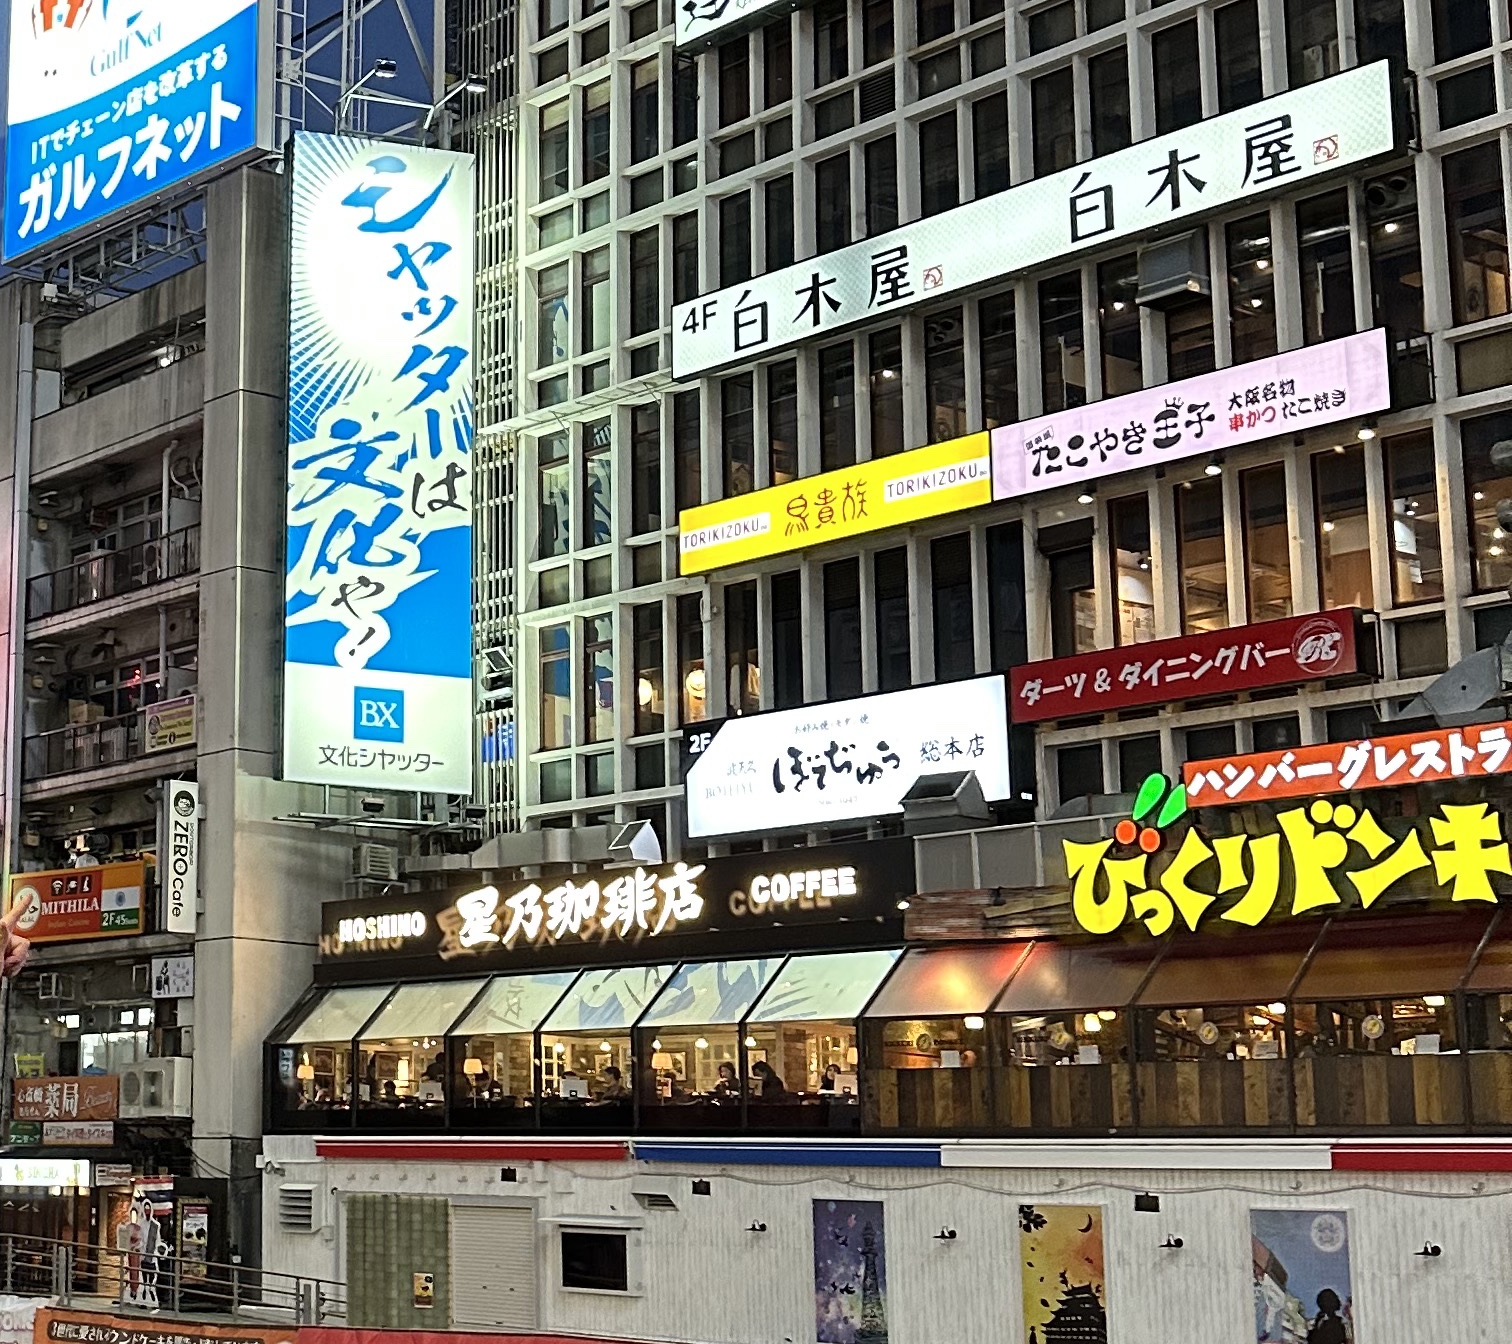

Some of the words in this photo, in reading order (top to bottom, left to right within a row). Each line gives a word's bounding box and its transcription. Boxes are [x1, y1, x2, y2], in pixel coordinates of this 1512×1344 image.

[30, 43, 228, 167] ITでチェーン店を改革する
[18, 89, 242, 240] ガルフネット
[733, 246, 917, 354] 白木屋
[1069, 114, 1304, 244] 白木屋
[681, 299, 718, 337] 4F
[1228, 378, 1296, 411] 大阪名物
[1228, 405, 1277, 432] 串かつ
[1032, 400, 1216, 477] たこやき王子
[887, 463, 979, 498] TORIKIZOKU
[684, 518, 760, 549] TORIKIZOKU
[1020, 668, 1088, 706] ダーツ
[1094, 667, 1112, 693] &
[1119, 641, 1291, 690] ダイニングバー
[360, 700, 400, 729] BX
[690, 733, 713, 754] 2F
[920, 733, 986, 764] 総本店
[173, 820, 188, 876] ZERO
[41, 897, 100, 915] MITHILA
[102, 912, 116, 926] 2F
[338, 910, 427, 943] HOSHINO
[453, 862, 708, 947] 星乃珈琲店
[750, 866, 858, 904] COFFEE
